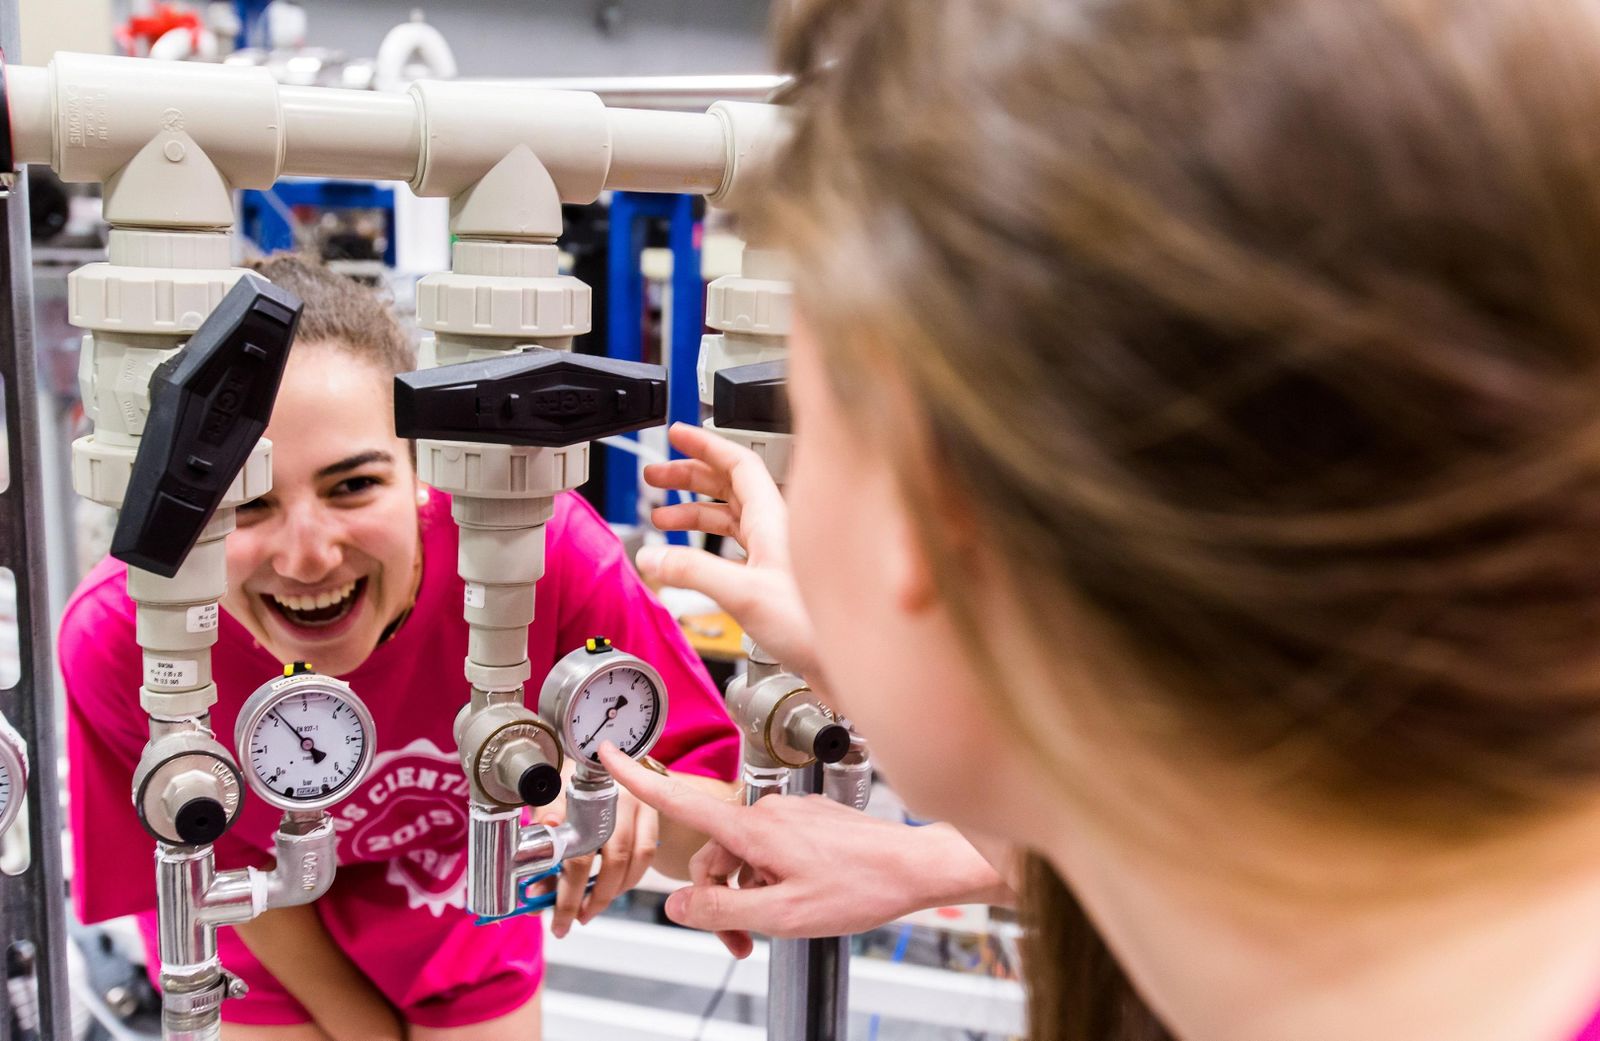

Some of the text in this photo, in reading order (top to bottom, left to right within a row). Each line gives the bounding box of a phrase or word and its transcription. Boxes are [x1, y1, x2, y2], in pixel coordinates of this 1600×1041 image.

[302, 701, 308, 712] 3
[332, 711, 337, 720] 4
[274, 718, 279, 728] 2
[345, 736, 351, 745] 5
[334, 761, 339, 771] 6
[276, 767, 281, 776] 0
[302, 779, 312, 787] bar
[366, 809, 454, 852] 2015
